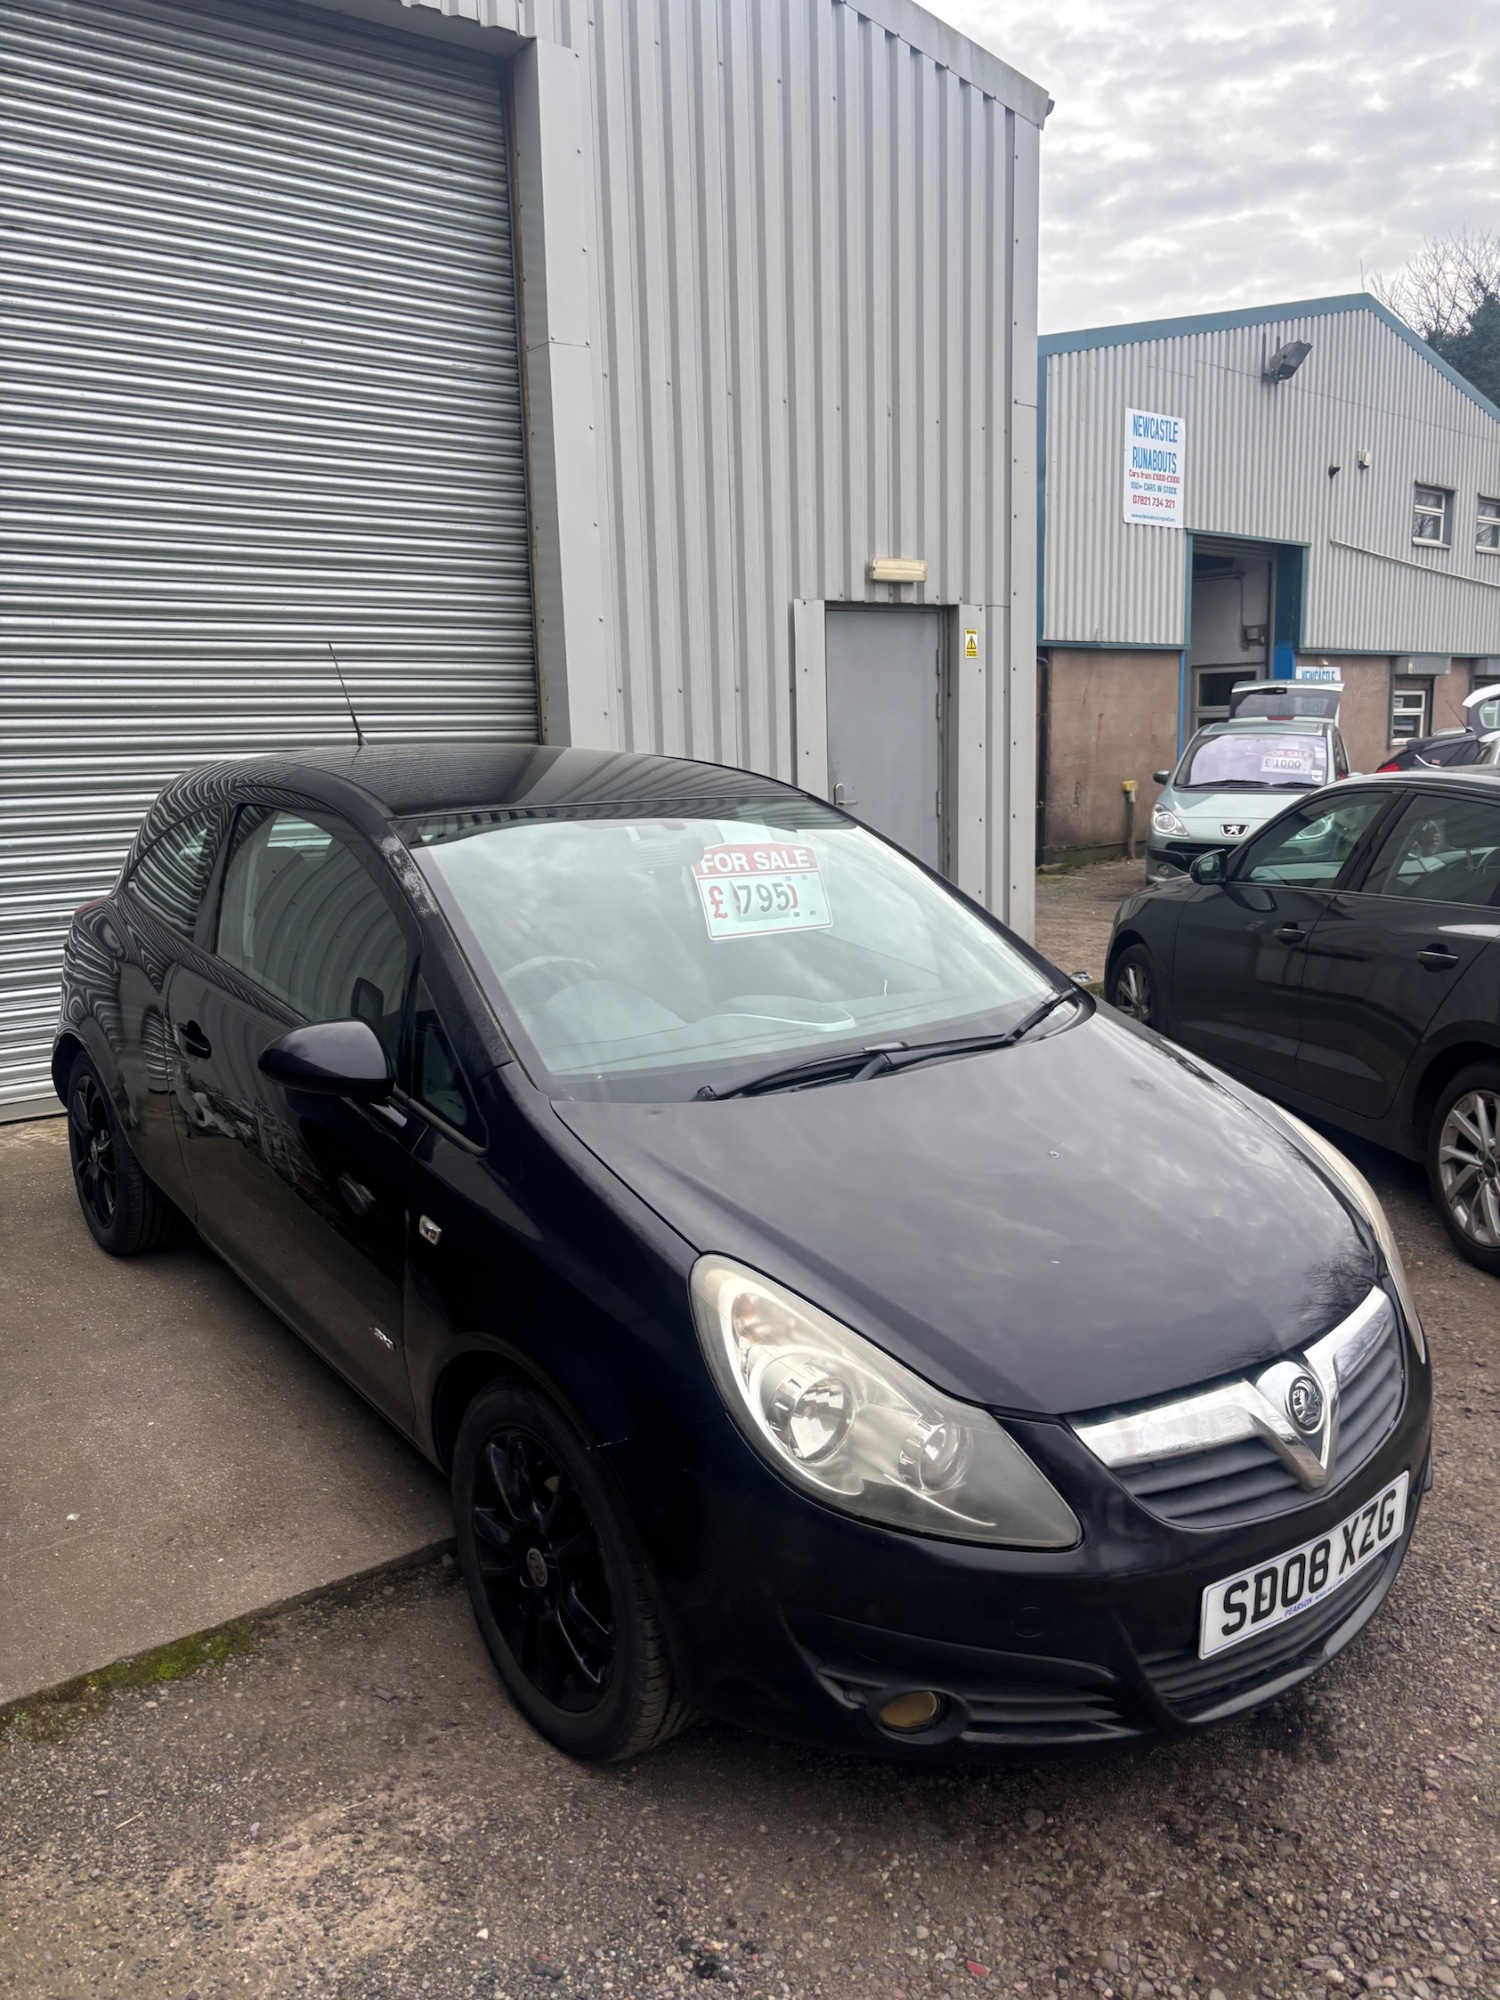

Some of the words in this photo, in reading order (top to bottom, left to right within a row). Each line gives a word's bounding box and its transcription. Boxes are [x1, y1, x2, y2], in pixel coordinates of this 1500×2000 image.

[1132, 414, 1178, 443] NEWCASTLE
[1132, 446, 1177, 474] RUNABOUTS
[1129, 469, 1139, 478] Cars
[1141, 471, 1152, 480] from
[1131, 481, 1143, 490] 100+
[1144, 483, 1156, 492] CARS
[1163, 486, 1177, 494] STOCK
[1132, 495, 1151, 506] 07821
[1152, 497, 1163, 507] 734
[1165, 499, 1175, 509] 321
[700, 852, 750, 874] FOR
[752, 849, 810, 871] SALE
[1221, 1538, 1331, 1636] SD08
[1339, 1488, 1397, 1576] XZG
